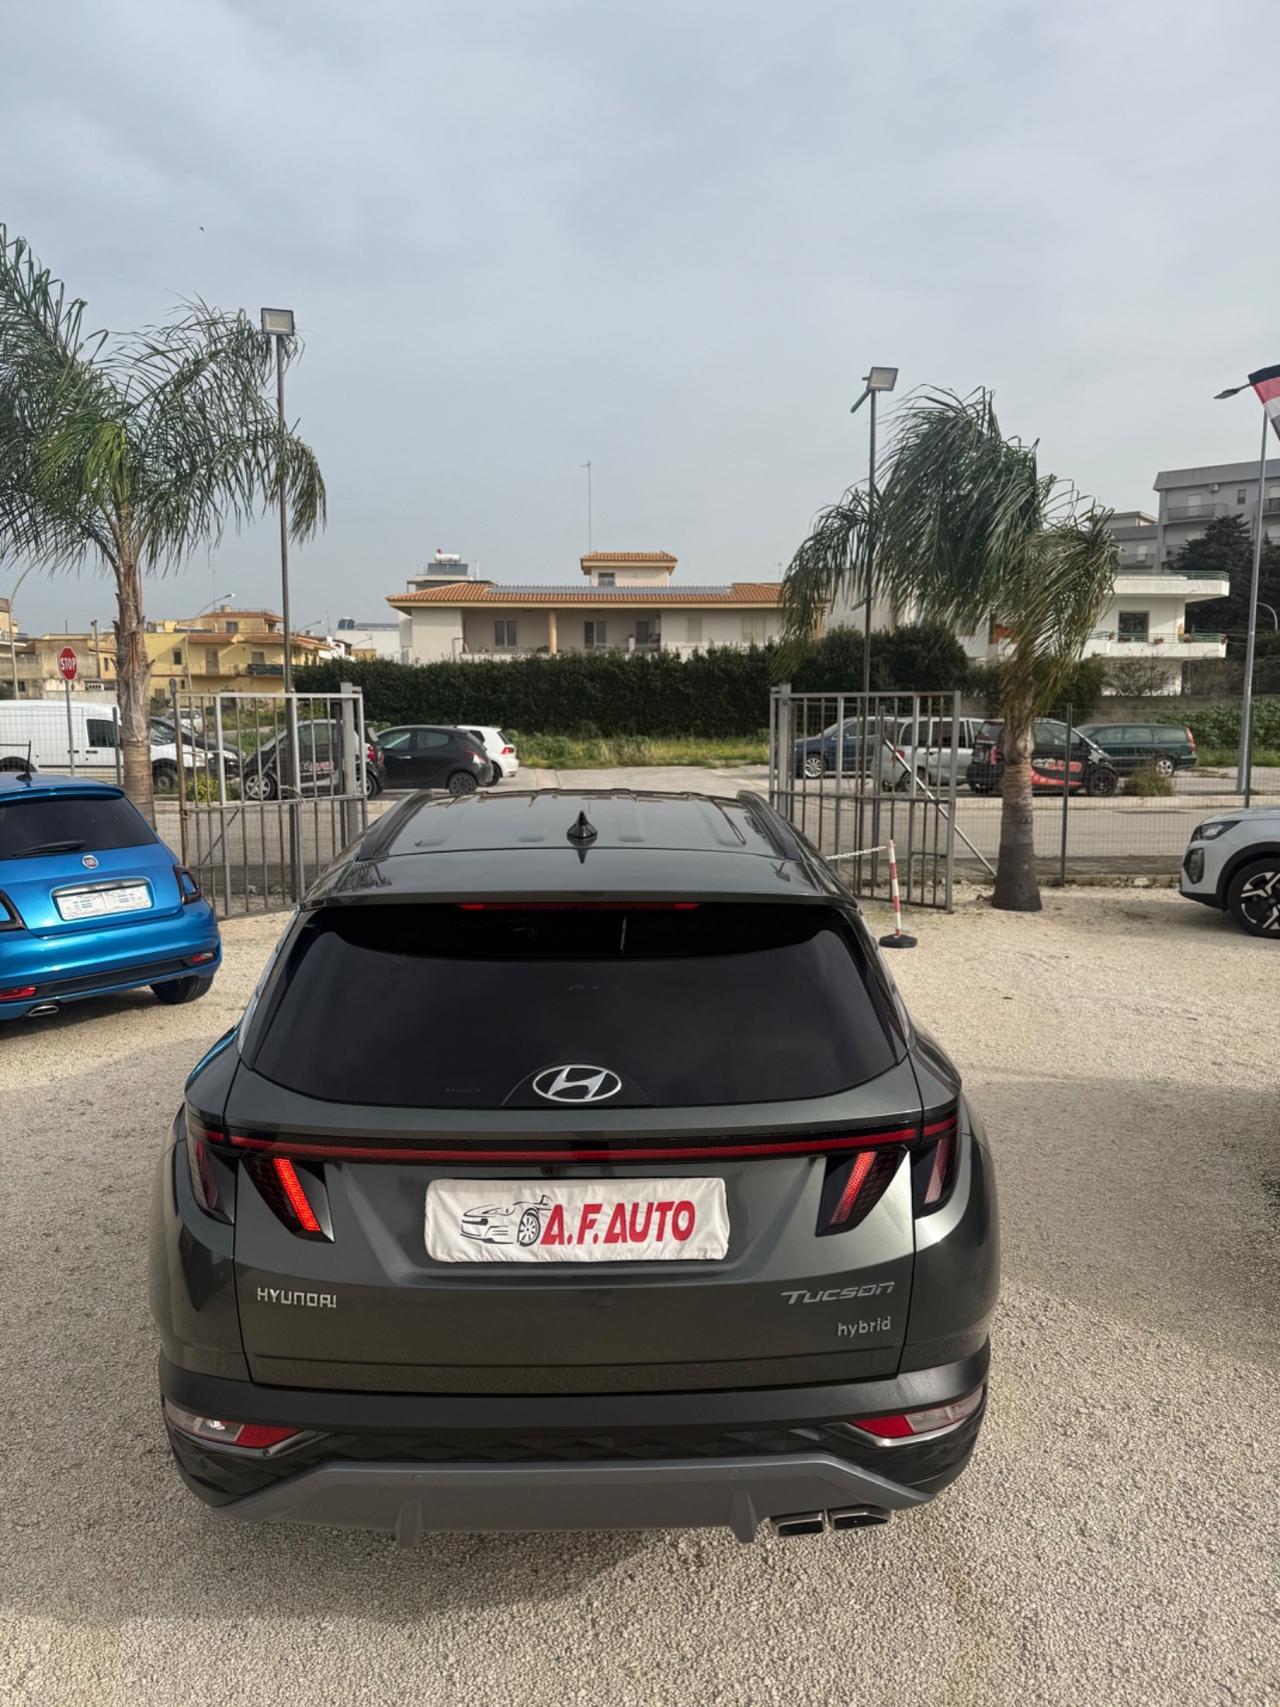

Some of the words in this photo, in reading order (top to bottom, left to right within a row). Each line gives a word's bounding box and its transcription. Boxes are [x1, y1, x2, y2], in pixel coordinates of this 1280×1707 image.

[61, 657, 76, 670] STOP
[257, 1287, 337, 1308] HYUNDAI
[837, 1316, 892, 1338] hybrid
